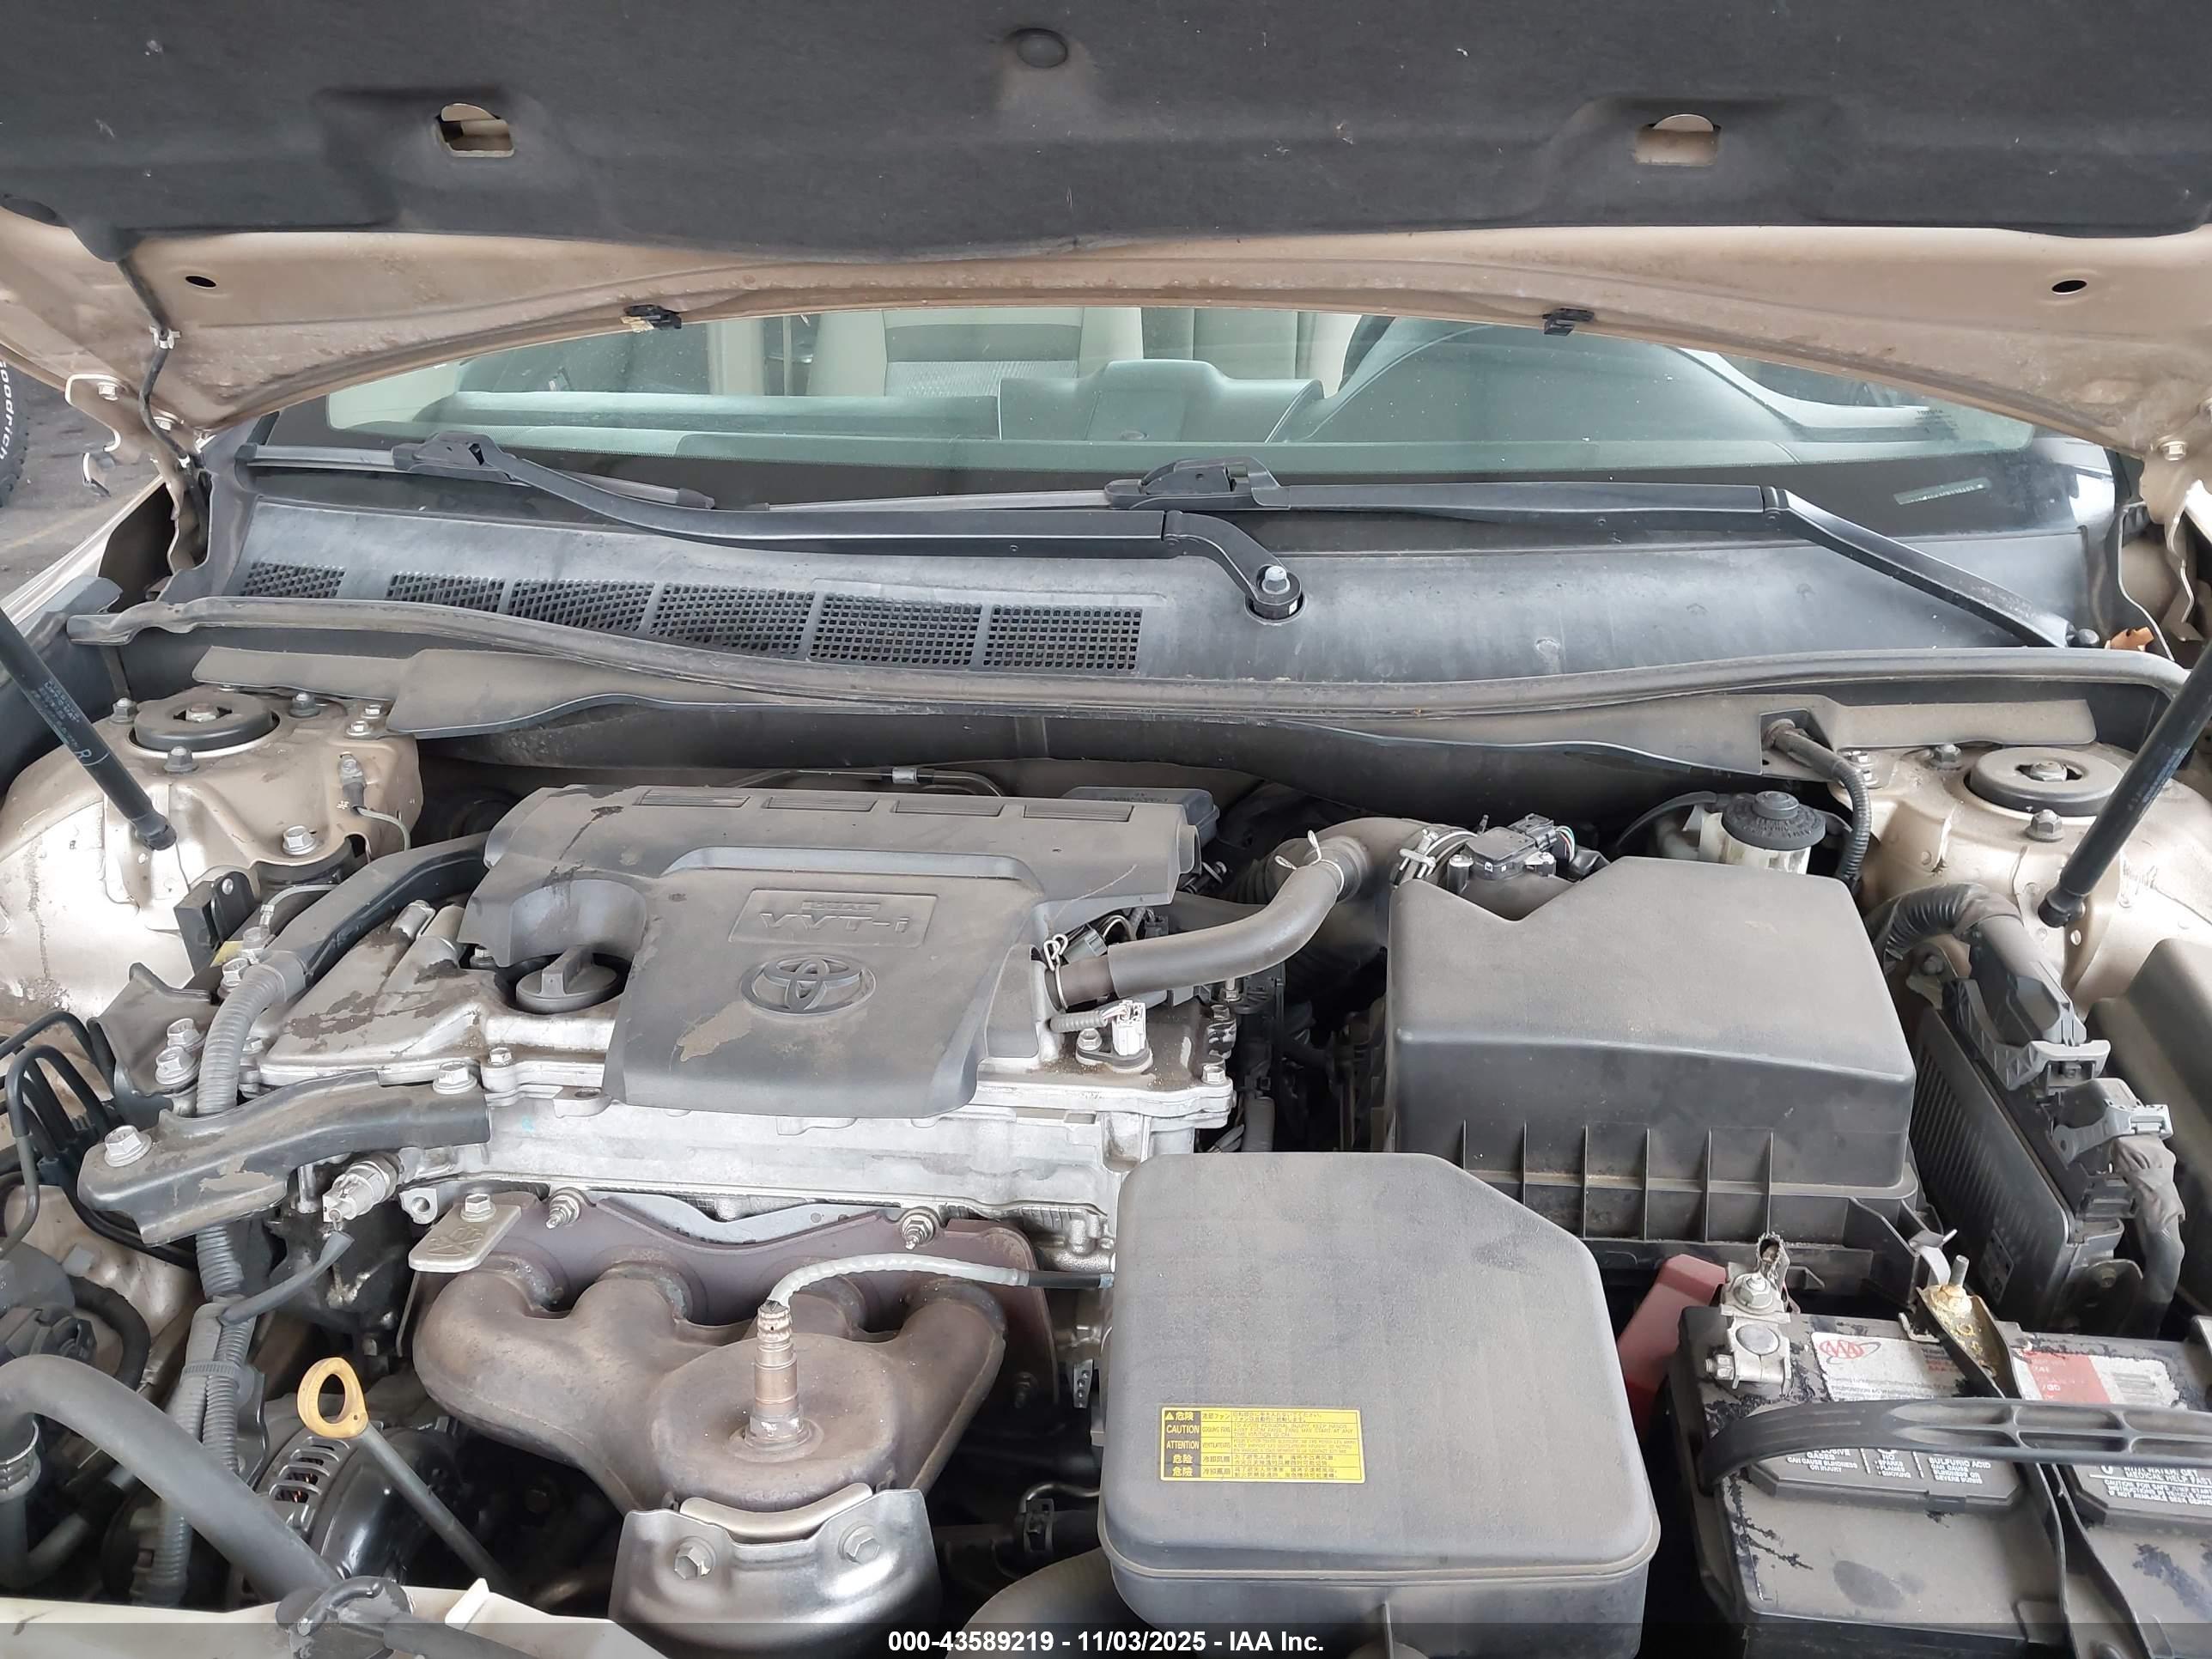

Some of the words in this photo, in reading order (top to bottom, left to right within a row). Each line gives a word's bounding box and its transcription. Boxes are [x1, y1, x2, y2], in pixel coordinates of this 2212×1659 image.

[760, 912, 910, 933] VVT-i
[1166, 1425, 1200, 1434] CAUTION
[1166, 1441, 1200, 1450] ATTENTION
[1929, 1457, 1971, 1467] SULFURIC
[1972, 1461, 1991, 1469] ACID
